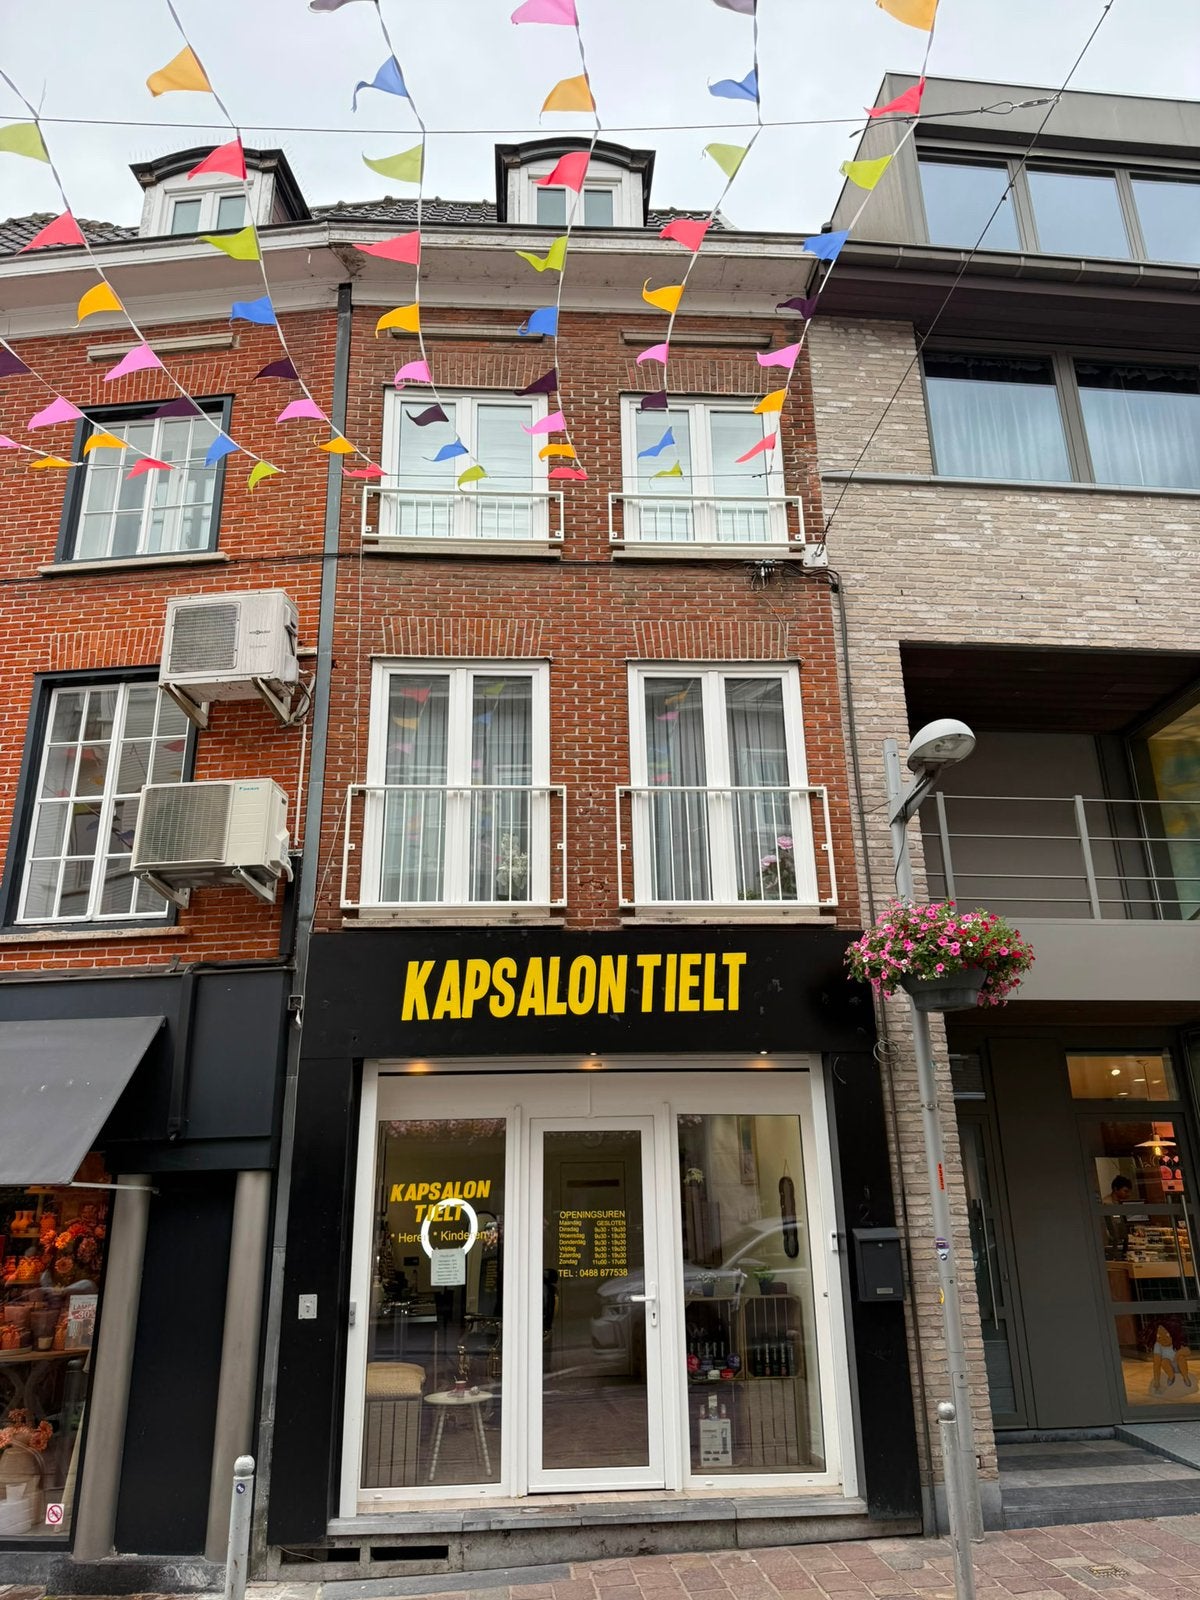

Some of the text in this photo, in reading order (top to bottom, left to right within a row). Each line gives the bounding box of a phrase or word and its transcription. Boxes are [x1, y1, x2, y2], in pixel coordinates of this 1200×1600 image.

[401, 952, 747, 1021] KAPSALON TIELT
[390, 1180, 491, 1202] KAPSALON
[415, 1203, 465, 1223] TIELT
[559, 1210, 626, 1219] OPENINGSUREN
[398, 1232, 428, 1243] Here
[558, 1269, 574, 1278] TEL
[579, 1268, 598, 1277] 0488
[600, 1268, 628, 1277] 877538
